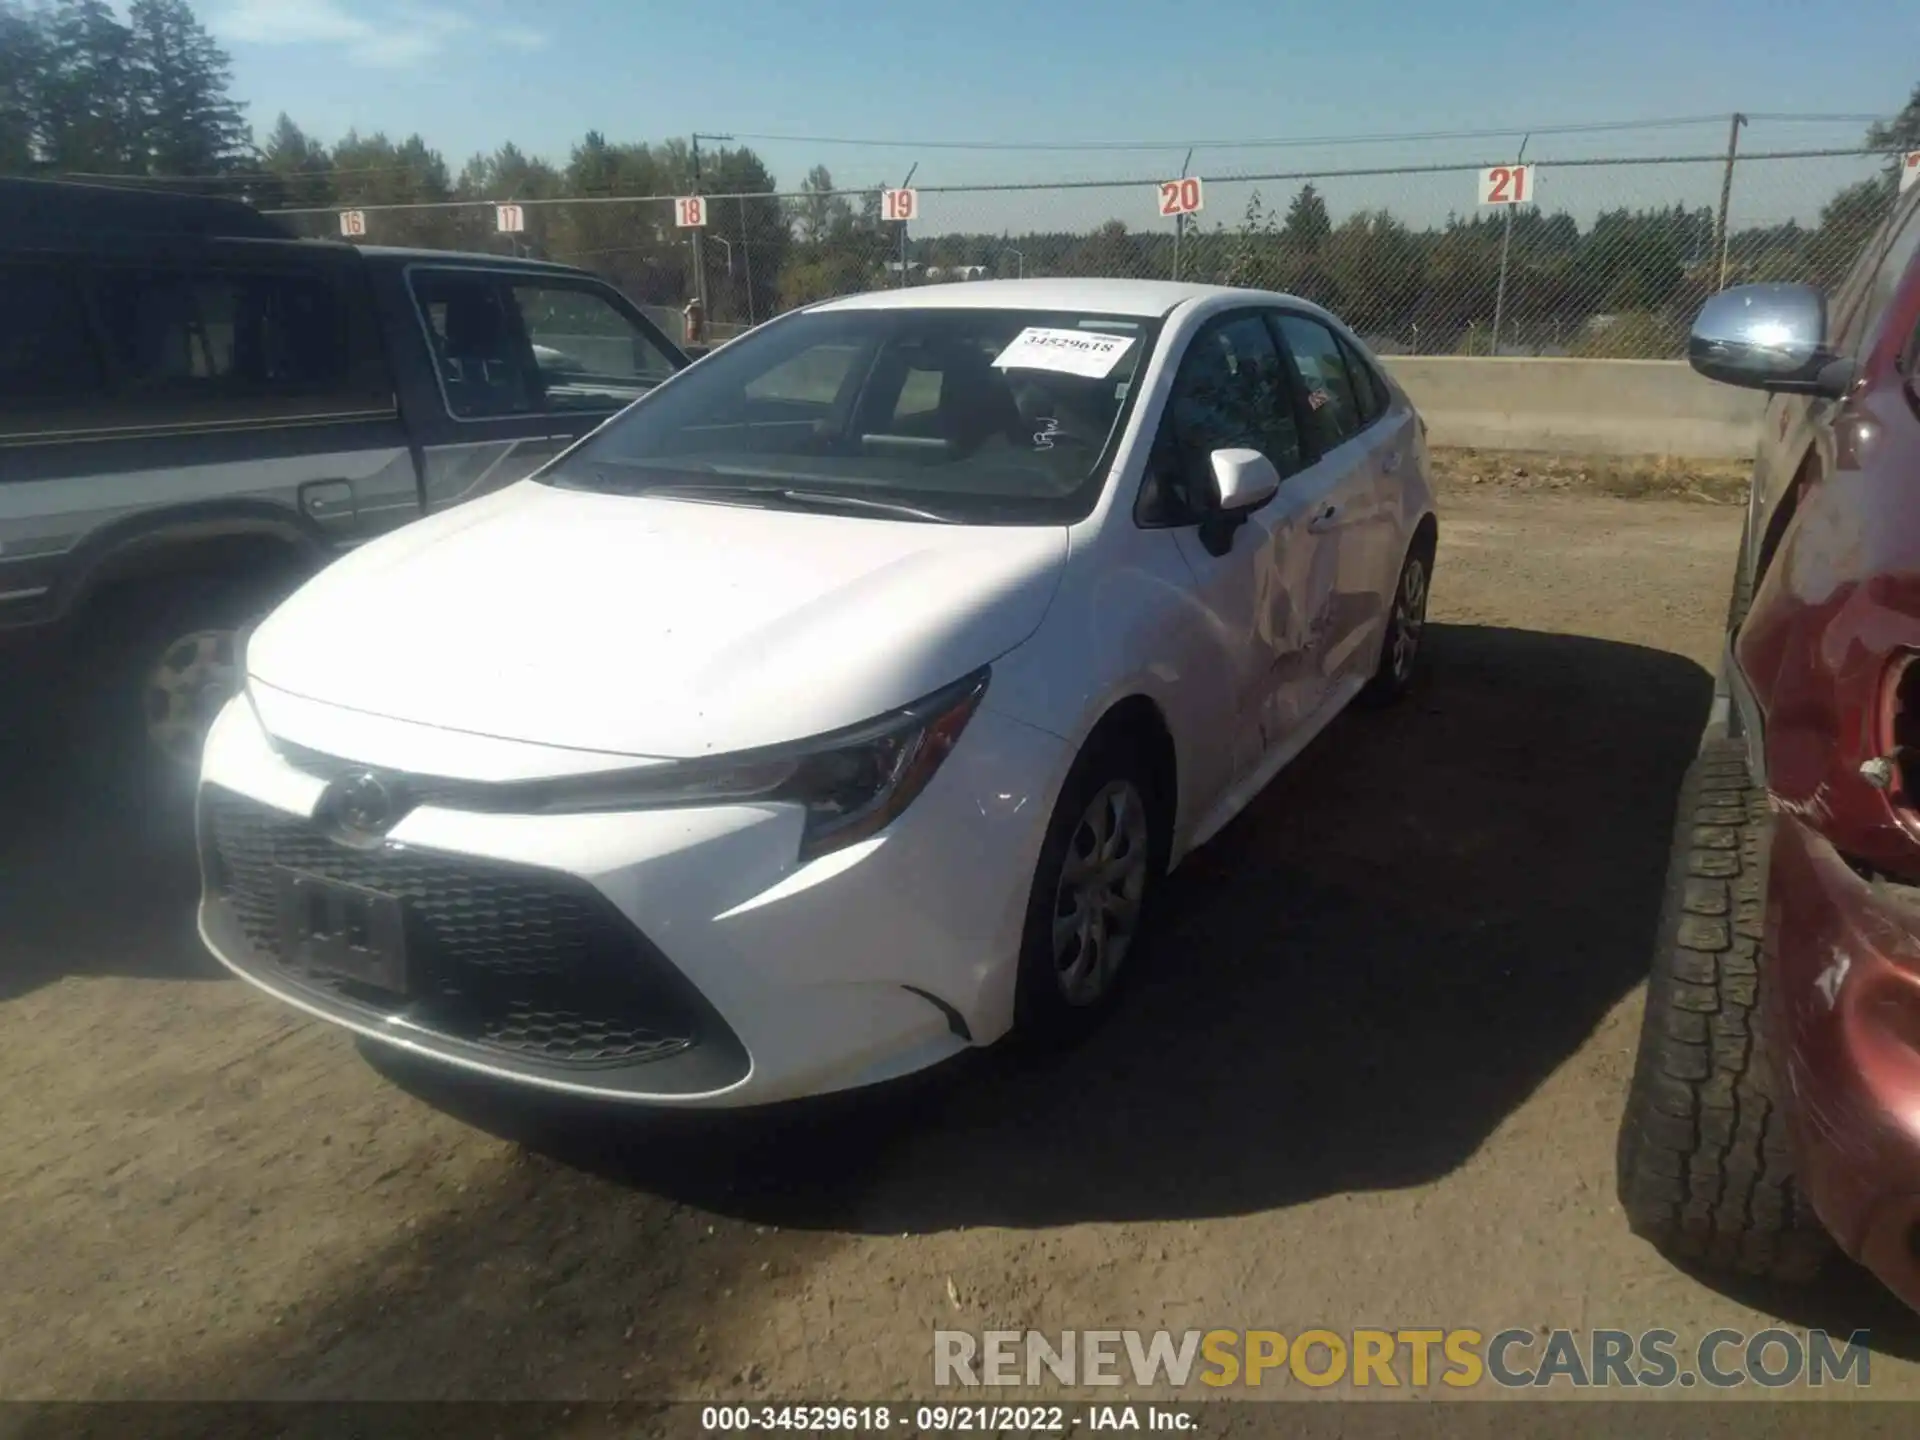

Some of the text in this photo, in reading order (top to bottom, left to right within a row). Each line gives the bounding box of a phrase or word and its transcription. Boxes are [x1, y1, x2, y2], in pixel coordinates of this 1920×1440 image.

[1162, 179, 1200, 215] 20
[1487, 167, 1524, 202] 21
[679, 198, 701, 225] 18
[887, 190, 913, 218] 19
[343, 213, 361, 233] 16
[503, 207, 518, 229] 17
[1024, 336, 1114, 353] 34529618
